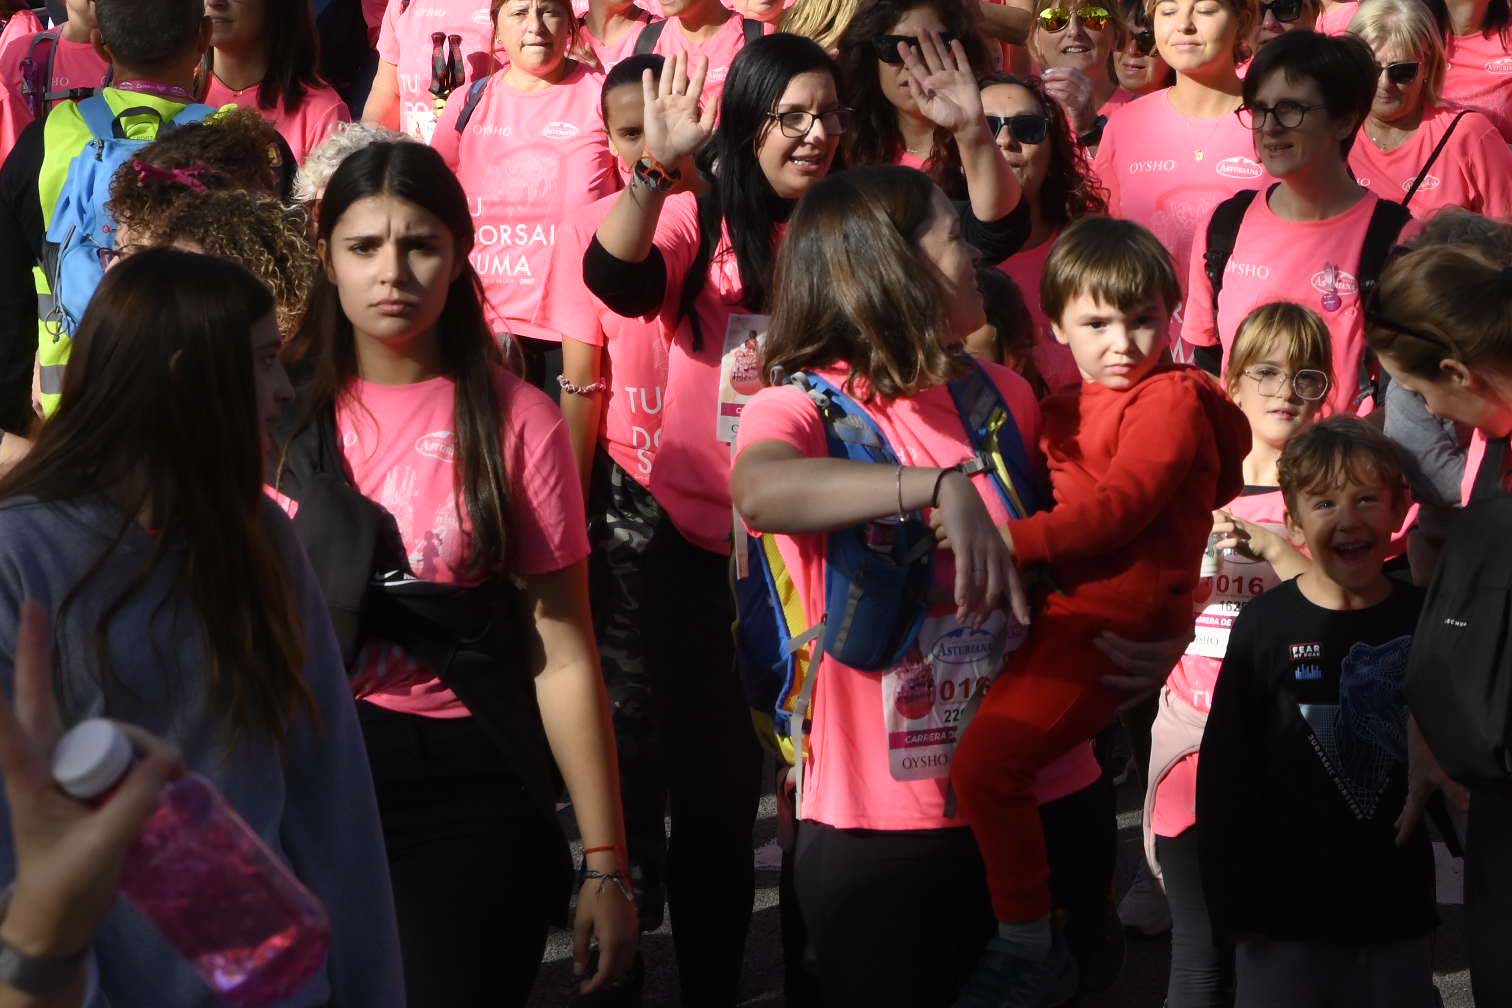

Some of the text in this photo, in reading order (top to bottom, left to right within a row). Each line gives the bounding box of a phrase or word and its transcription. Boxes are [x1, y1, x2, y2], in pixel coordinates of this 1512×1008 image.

[1129, 158, 1176, 174] OYSHO
[470, 253, 533, 276] UMA
[624, 385, 662, 415] TU
[1216, 575, 1265, 597] 016
[1292, 644, 1321, 654] FEAR
[944, 707, 965, 724] 22
[902, 753, 948, 771] OYSHO
